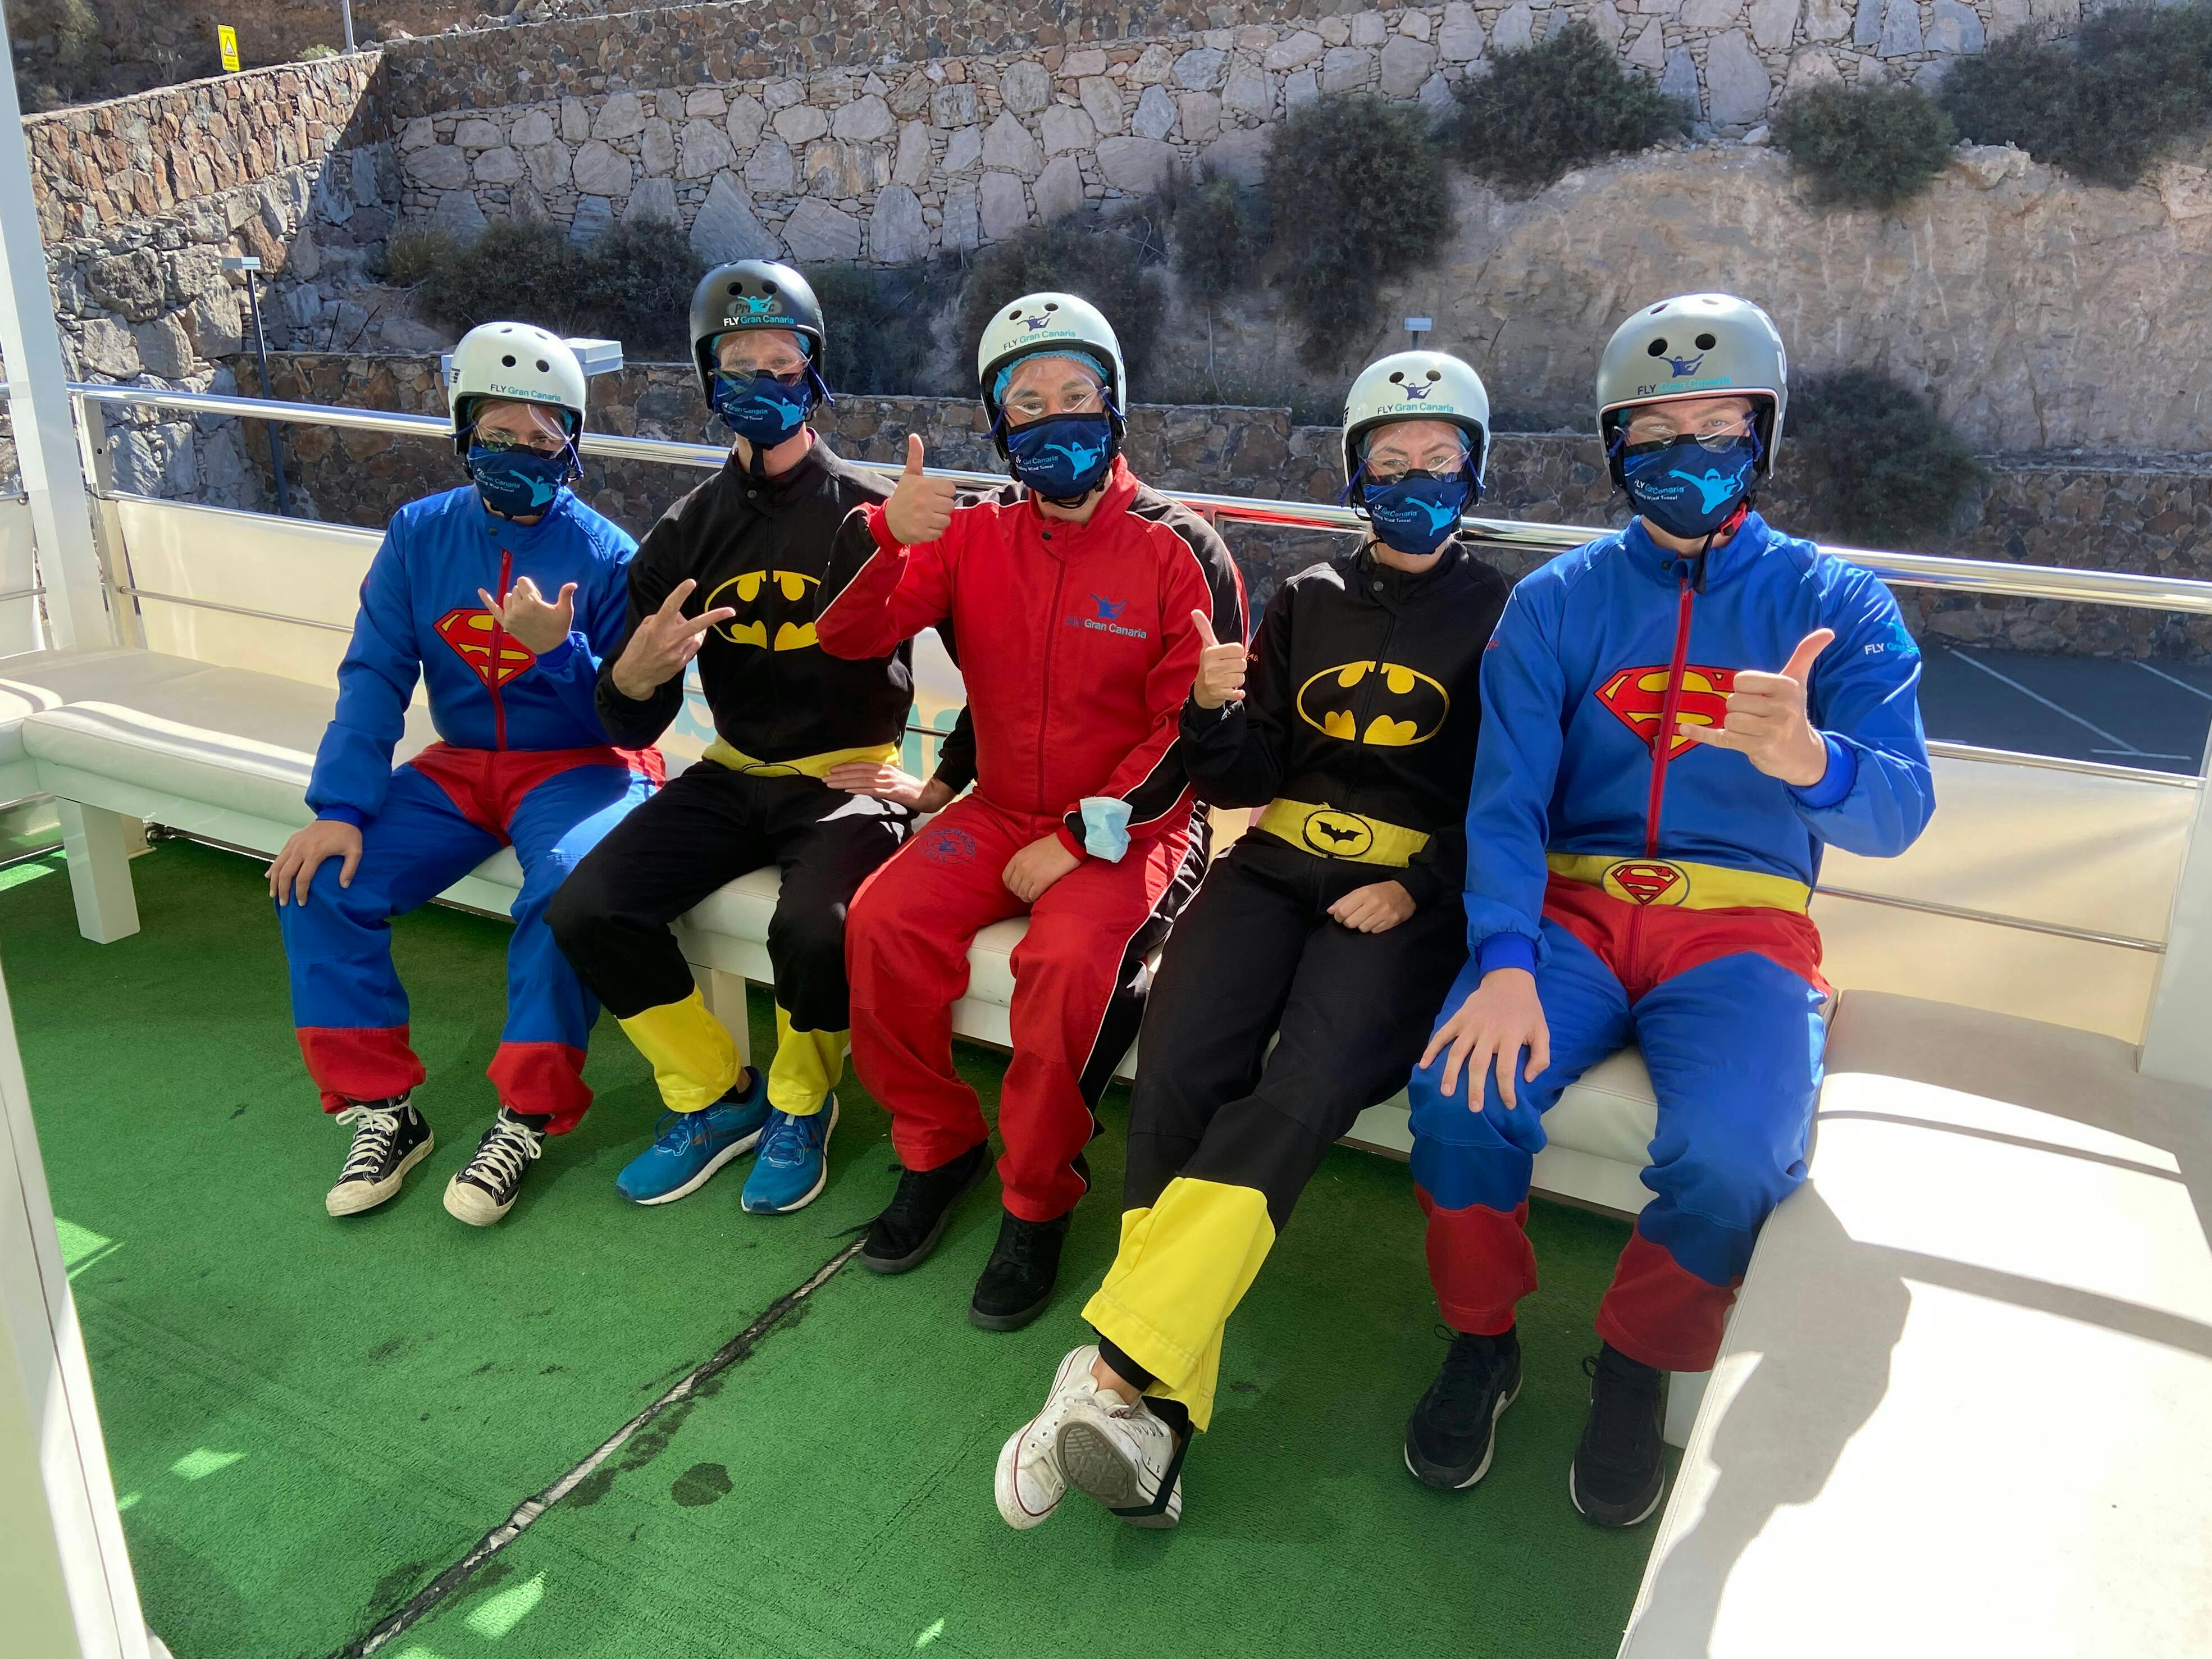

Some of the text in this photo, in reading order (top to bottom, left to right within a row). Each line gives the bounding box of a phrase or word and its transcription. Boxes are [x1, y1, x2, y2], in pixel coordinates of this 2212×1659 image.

[723, 317, 739, 326] FLY
[763, 315, 795, 324] Canaria
[1003, 339, 1018, 350] FLY
[1019, 333, 1040, 343] Gran
[1638, 377, 1731, 395] FLY Gran Canaria
[490, 384, 561, 402] FLY Gran Canaria
[1378, 404, 1393, 414] FLY
[1420, 403, 1454, 413] Canaria
[494, 478, 520, 489] Canaria
[1653, 486, 1684, 494] Canaria
[1084, 619, 1107, 631] Gran
[1109, 623, 1147, 639] Canaria
[1864, 642, 1885, 655] FLY
